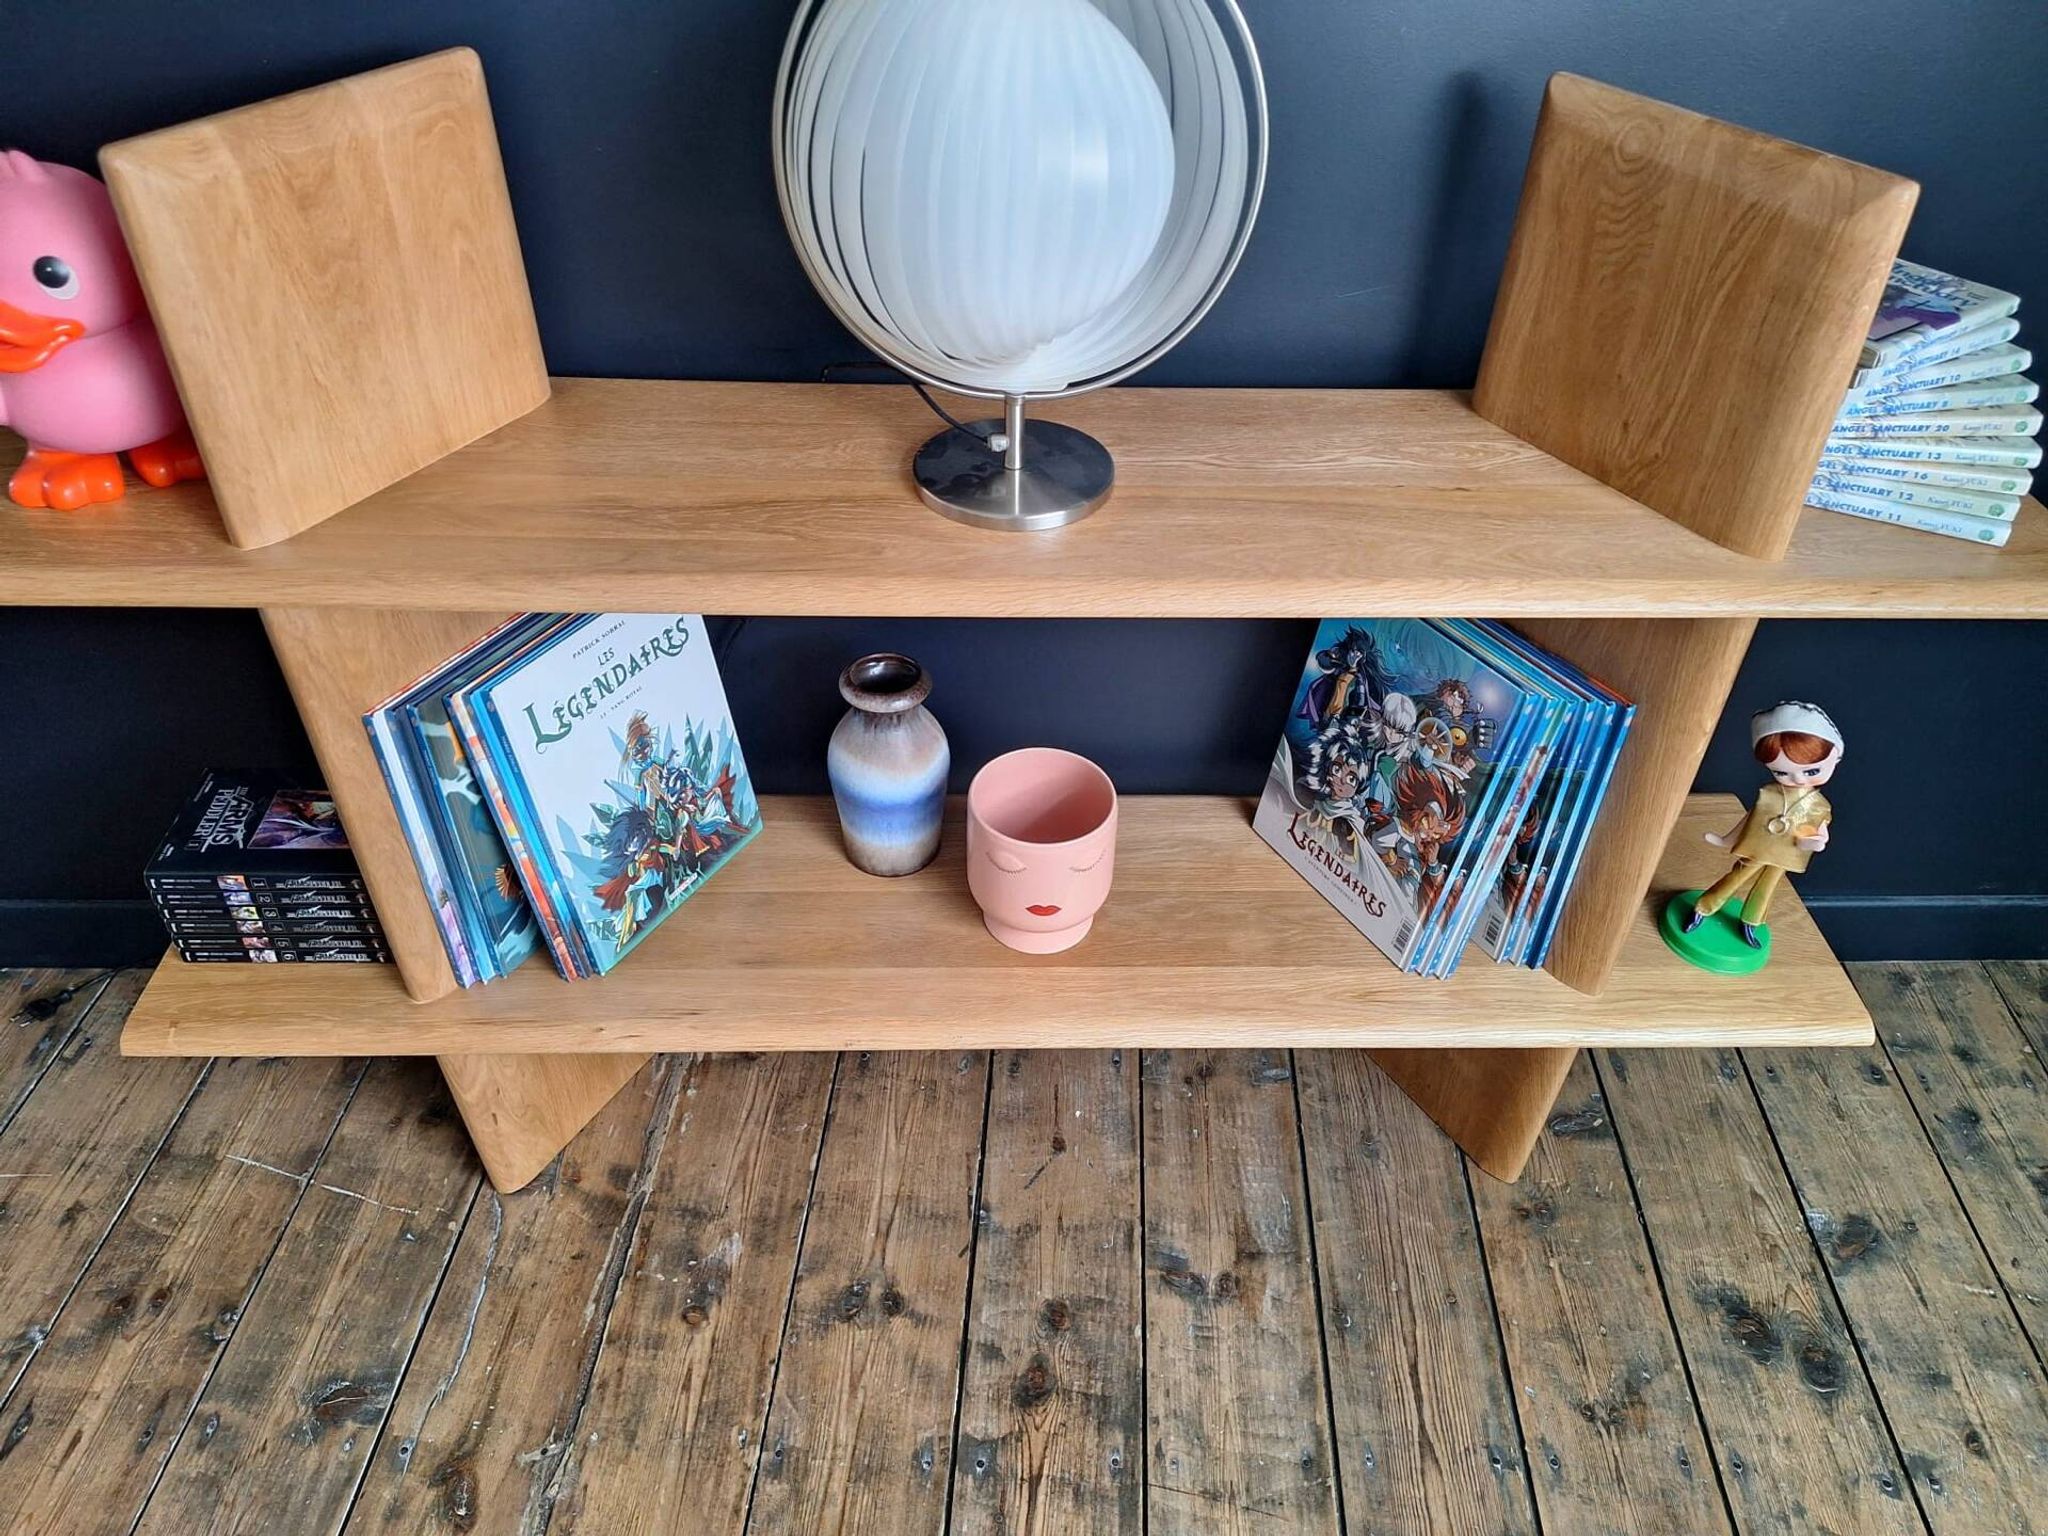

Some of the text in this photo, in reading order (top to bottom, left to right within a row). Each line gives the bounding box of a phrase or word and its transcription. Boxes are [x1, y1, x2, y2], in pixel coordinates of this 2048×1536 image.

[1866, 386, 1893, 397] ANGEL
[1898, 376, 1945, 393] SANCTUARY
[1846, 406, 1877, 416] ANGEL
[1881, 400, 1938, 414] SANCTUARY
[1832, 425, 1866, 433] ANGEL
[1870, 424, 1931, 434] SANCTUARY
[1935, 424, 1950, 432] 20
[1824, 445, 1853, 454] NGEL
[1856, 447, 1922, 459] SANCTUARY
[1928, 452, 1942, 460] 13
[1817, 460, 1838, 470] GEL
[1842, 463, 1909, 478] SANCTUARY
[1914, 472, 1929, 480] 16
[1826, 478, 1894, 497] SANCTUARY
[1899, 491, 1914, 501] 12
[1816, 497, 1883, 517] SANCTUARY
[1888, 512, 1902, 521] 11
[572, 637, 601, 660] PATRICK
[597, 647, 615, 666] LES
[522, 615, 690, 754] LÉGENDAIRES
[192, 789, 234, 840] PEDDLER
